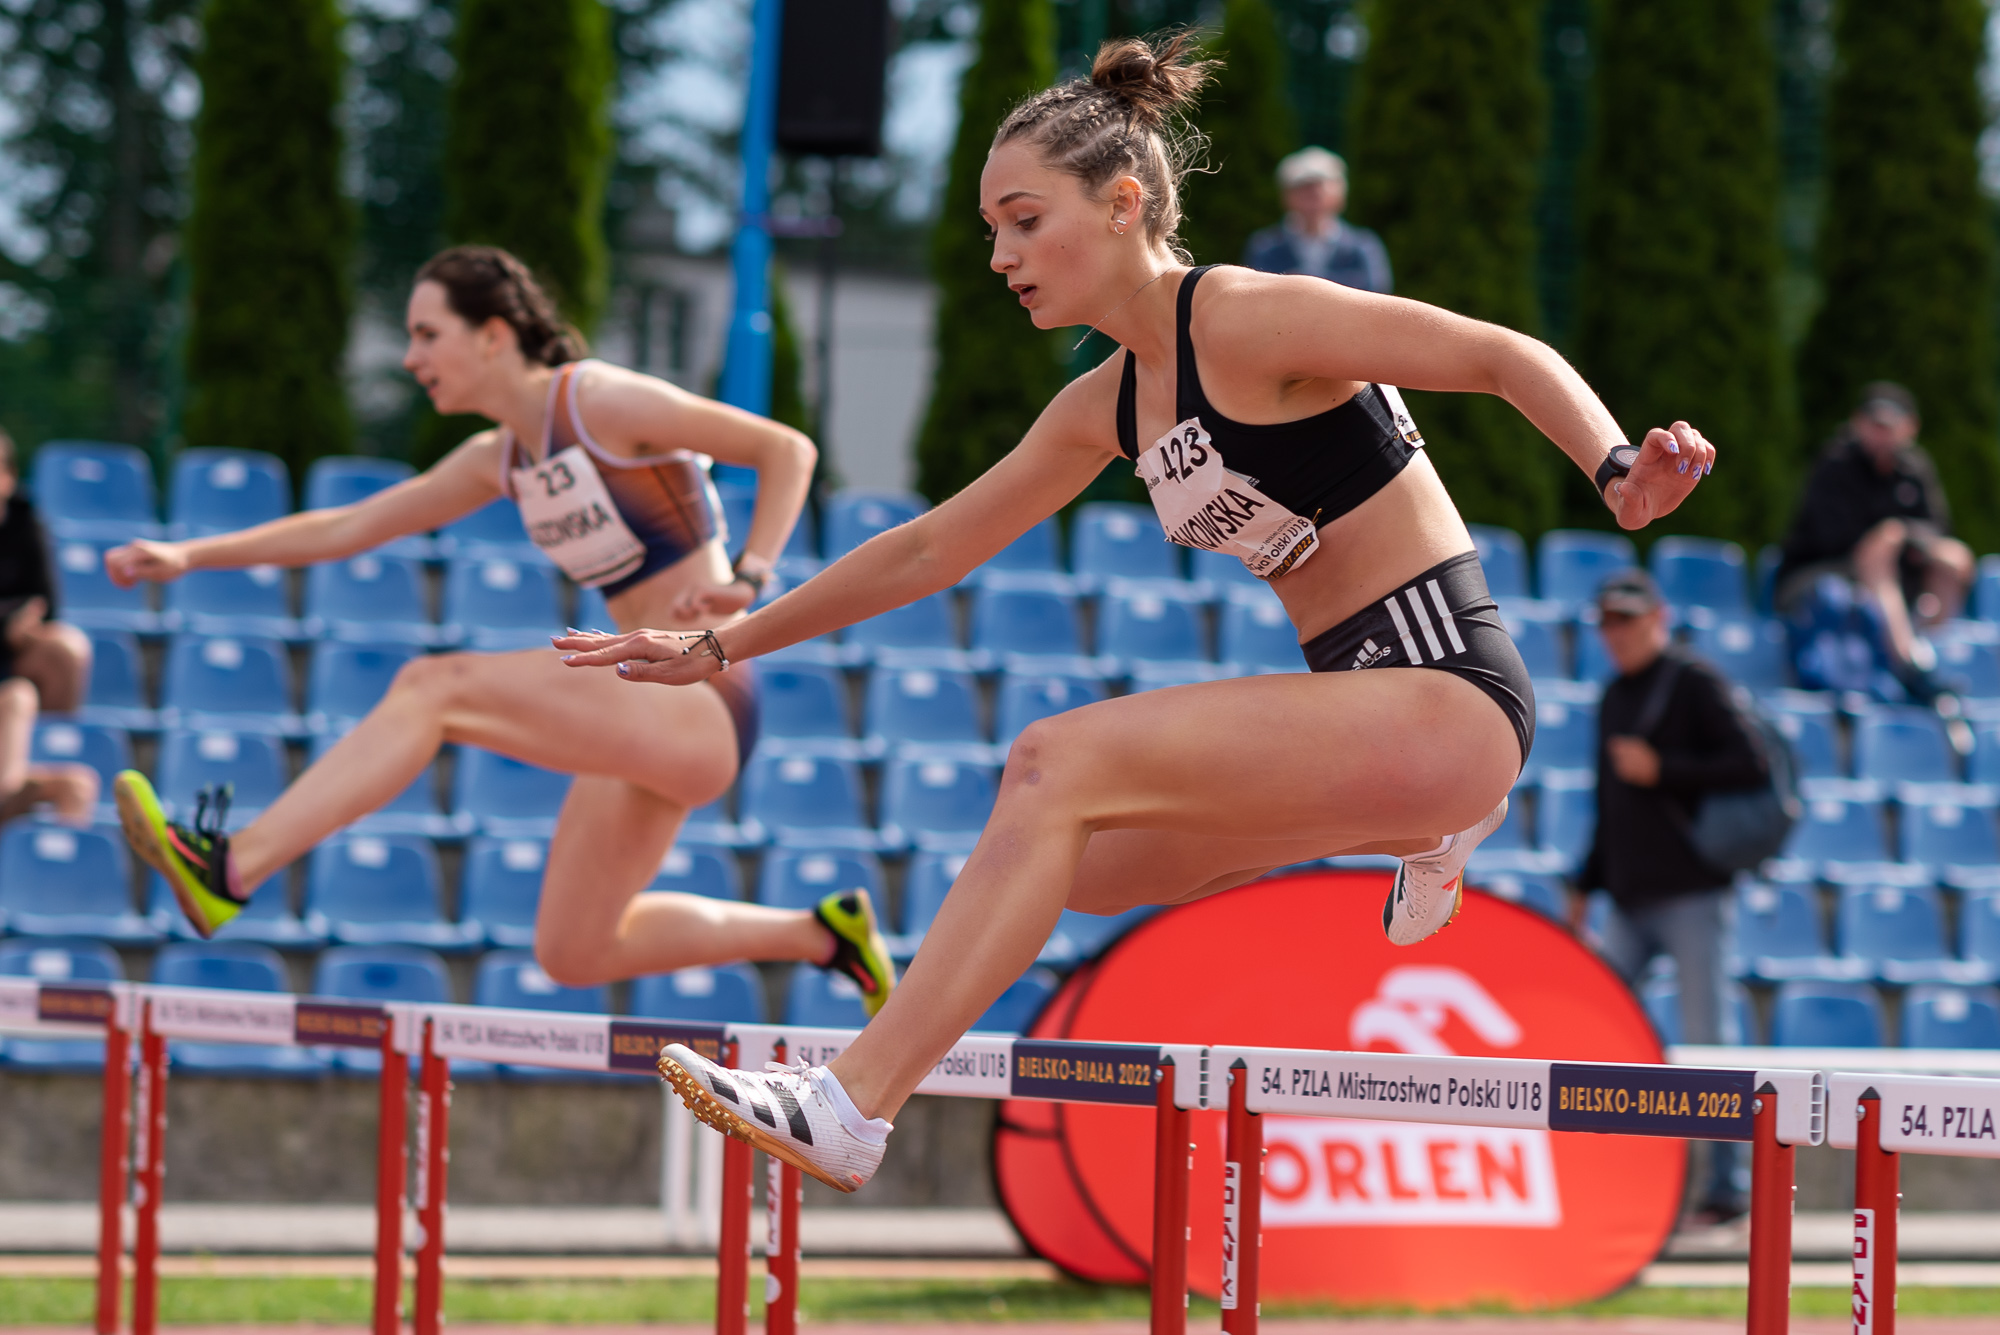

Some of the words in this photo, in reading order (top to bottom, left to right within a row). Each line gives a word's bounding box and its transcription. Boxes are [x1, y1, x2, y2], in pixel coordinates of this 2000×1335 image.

[1160, 427, 1208, 484] 423
[537, 461, 576, 497] 23
[1287, 518, 1309, 538] U18
[980, 1053, 1006, 1079] U18
[1018, 1056, 1115, 1084] BIELSKO-BIAŁA
[1118, 1063, 1151, 1086] 2022
[1261, 1067, 1286, 1096] 54.
[1292, 1069, 1332, 1098] PZLA
[1337, 1071, 1441, 1106] Mistrzostwa
[1448, 1078, 1500, 1109] Polski
[1507, 1082, 1542, 1112] U18
[1559, 1086, 1692, 1117] BIELSKO-BIAŁA
[1697, 1092, 1742, 1119] 2022
[1900, 1104, 1933, 1138] 54.
[1942, 1106, 1996, 1141] PZLA
[1262, 1138, 1530, 1203] ORLEN
